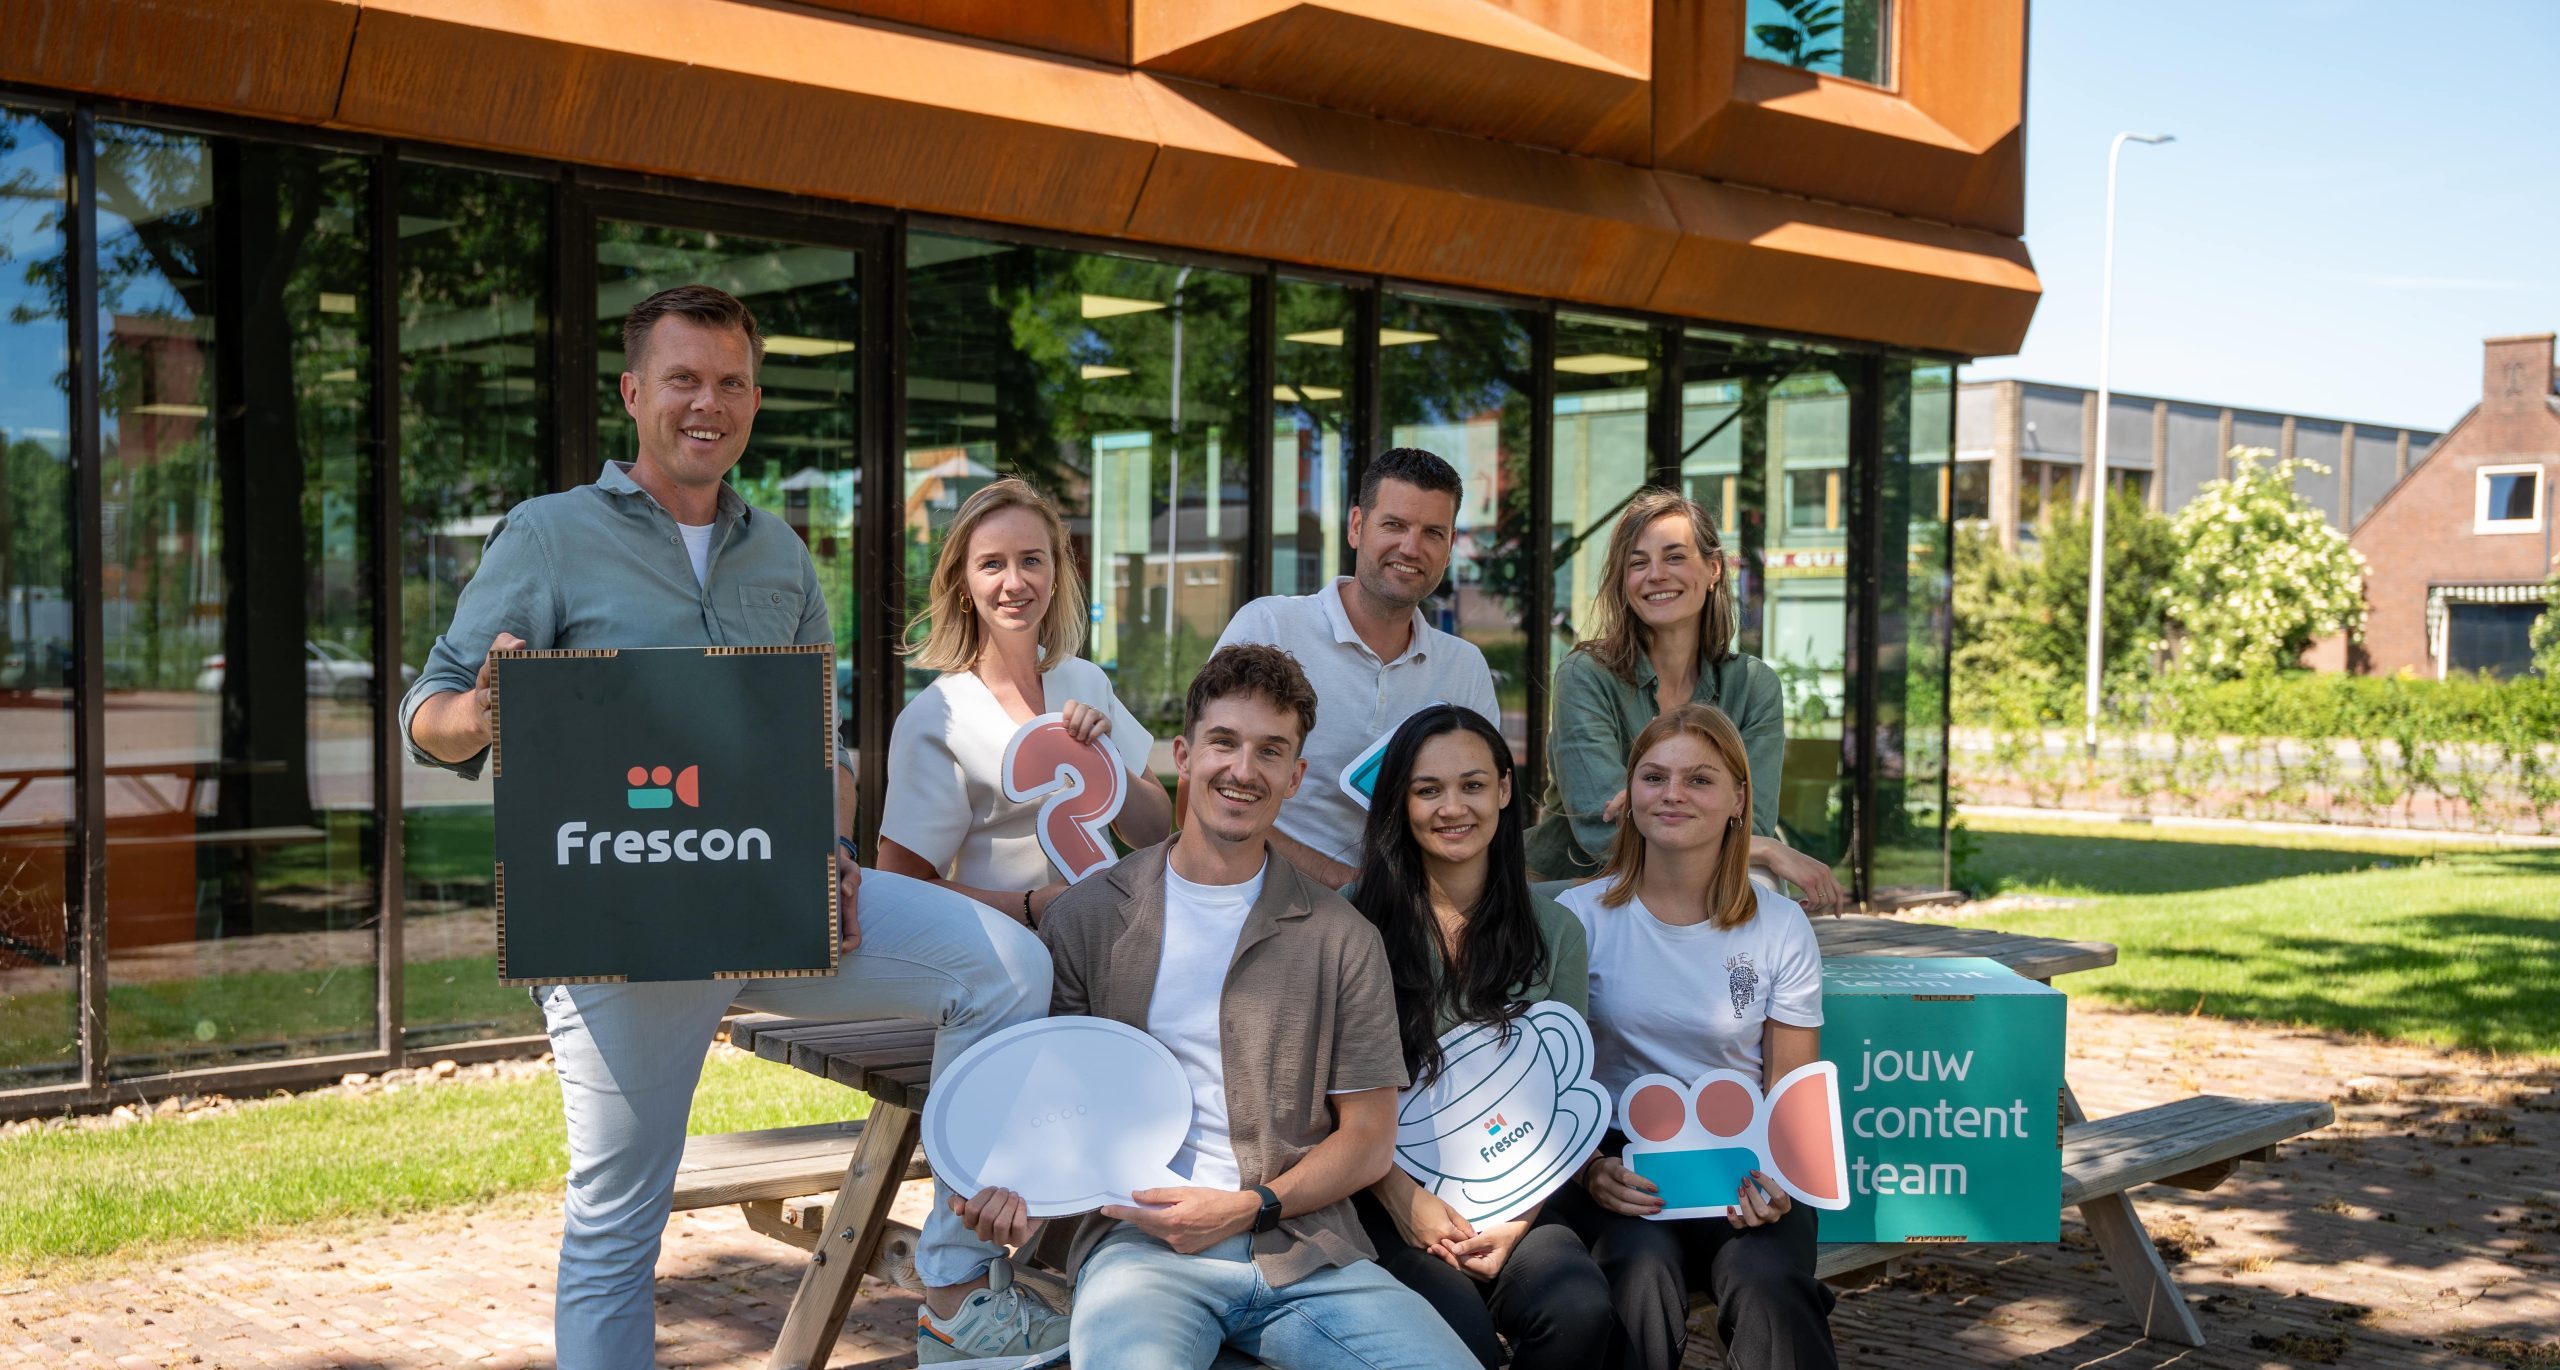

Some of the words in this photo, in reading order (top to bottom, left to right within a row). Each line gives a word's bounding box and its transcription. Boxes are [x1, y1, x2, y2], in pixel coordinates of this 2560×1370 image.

[557, 821, 772, 865] Frescon
[1822, 963, 1915, 971] ouw
[1822, 971, 1993, 979] content
[1832, 979, 1952, 987] team
[1853, 1039, 1974, 1092] jouw
[1852, 1099, 2029, 1139] content
[1480, 1121, 1535, 1163] Frescon
[1851, 1156, 1967, 1195] team
